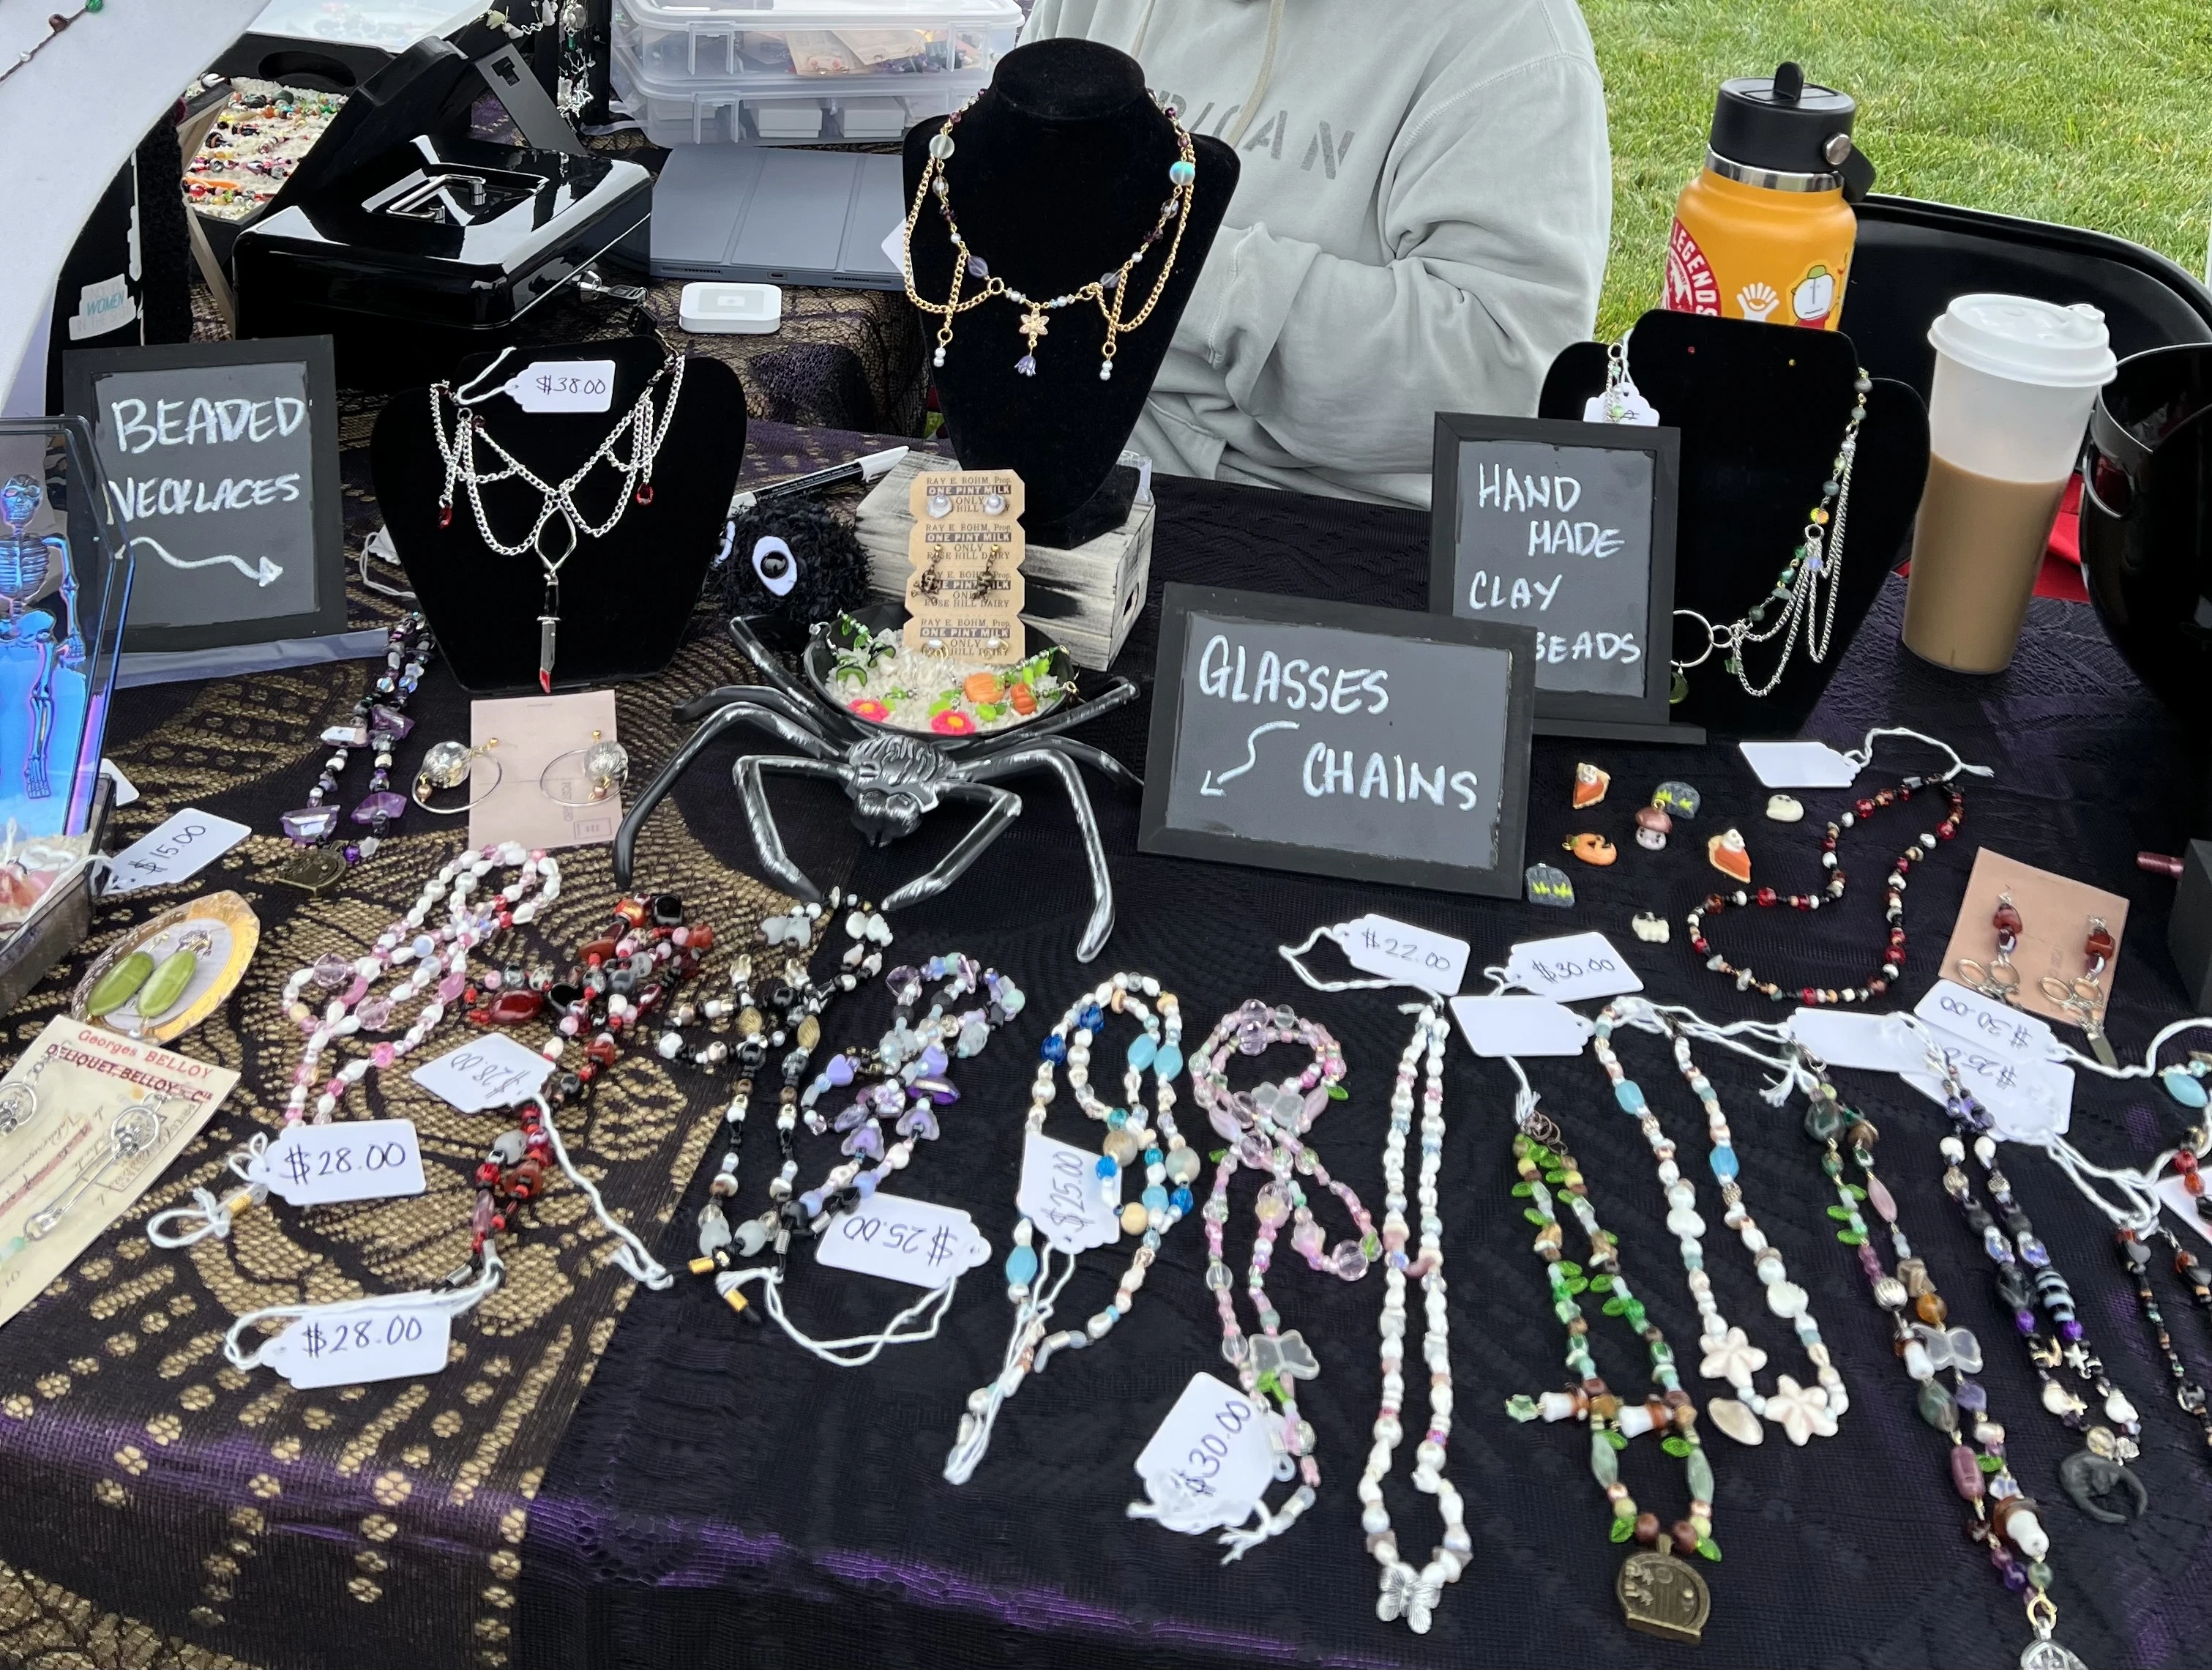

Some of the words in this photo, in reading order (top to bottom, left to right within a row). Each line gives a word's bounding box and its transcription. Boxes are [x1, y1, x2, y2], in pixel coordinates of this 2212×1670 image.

[86, 290, 124, 316] WOMEN
[536, 374, 606, 395] $38.00
[111, 396, 306, 455] BEADED
[928, 485, 952, 495] ONE
[956, 485, 981, 494] PINT
[984, 485, 1010, 495] MILK
[994, 476, 1012, 486] Prop.
[1478, 462, 1582, 512] HAND
[101, 471, 301, 526] NECKLACES
[956, 496, 984, 505] ONLY
[957, 504, 979, 512] HILL
[925, 523, 945, 532] RAY
[994, 523, 1012, 533] Prop.
[927, 533, 951, 542] ONE
[954, 533, 981, 542] PINT
[983, 532, 1010, 542] MILK
[1528, 519, 1626, 559] MADE
[954, 543, 984, 552] ONLY
[955, 551, 978, 560] HILL
[991, 580, 1009, 589] ILK
[1468, 569, 1563, 611] CLAY
[953, 599, 977, 608] HILL
[922, 627, 946, 637] ONE
[951, 627, 978, 637] PINT
[981, 628, 1009, 638] MILK
[993, 619, 1012, 629] Prop.
[950, 638, 981, 647] ONLY
[1198, 633, 1390, 715] GLASSES
[1301, 741, 1479, 812] CHAINS
[127, 824, 207, 875] $15.00
[1361, 927, 1451, 971] $22.00
[1531, 958, 1615, 983] $30.00
[78, 1029, 138, 1056] Georges
[144, 1049, 215, 1080] BELLOY
[1942, 1045, 2017, 1091] $25.0
[278, 1141, 407, 1185] $28.00
[1039, 1150, 1096, 1234] $25.00
[842, 1215, 959, 1267] $25.00
[301, 1314, 422, 1359] $28.00
